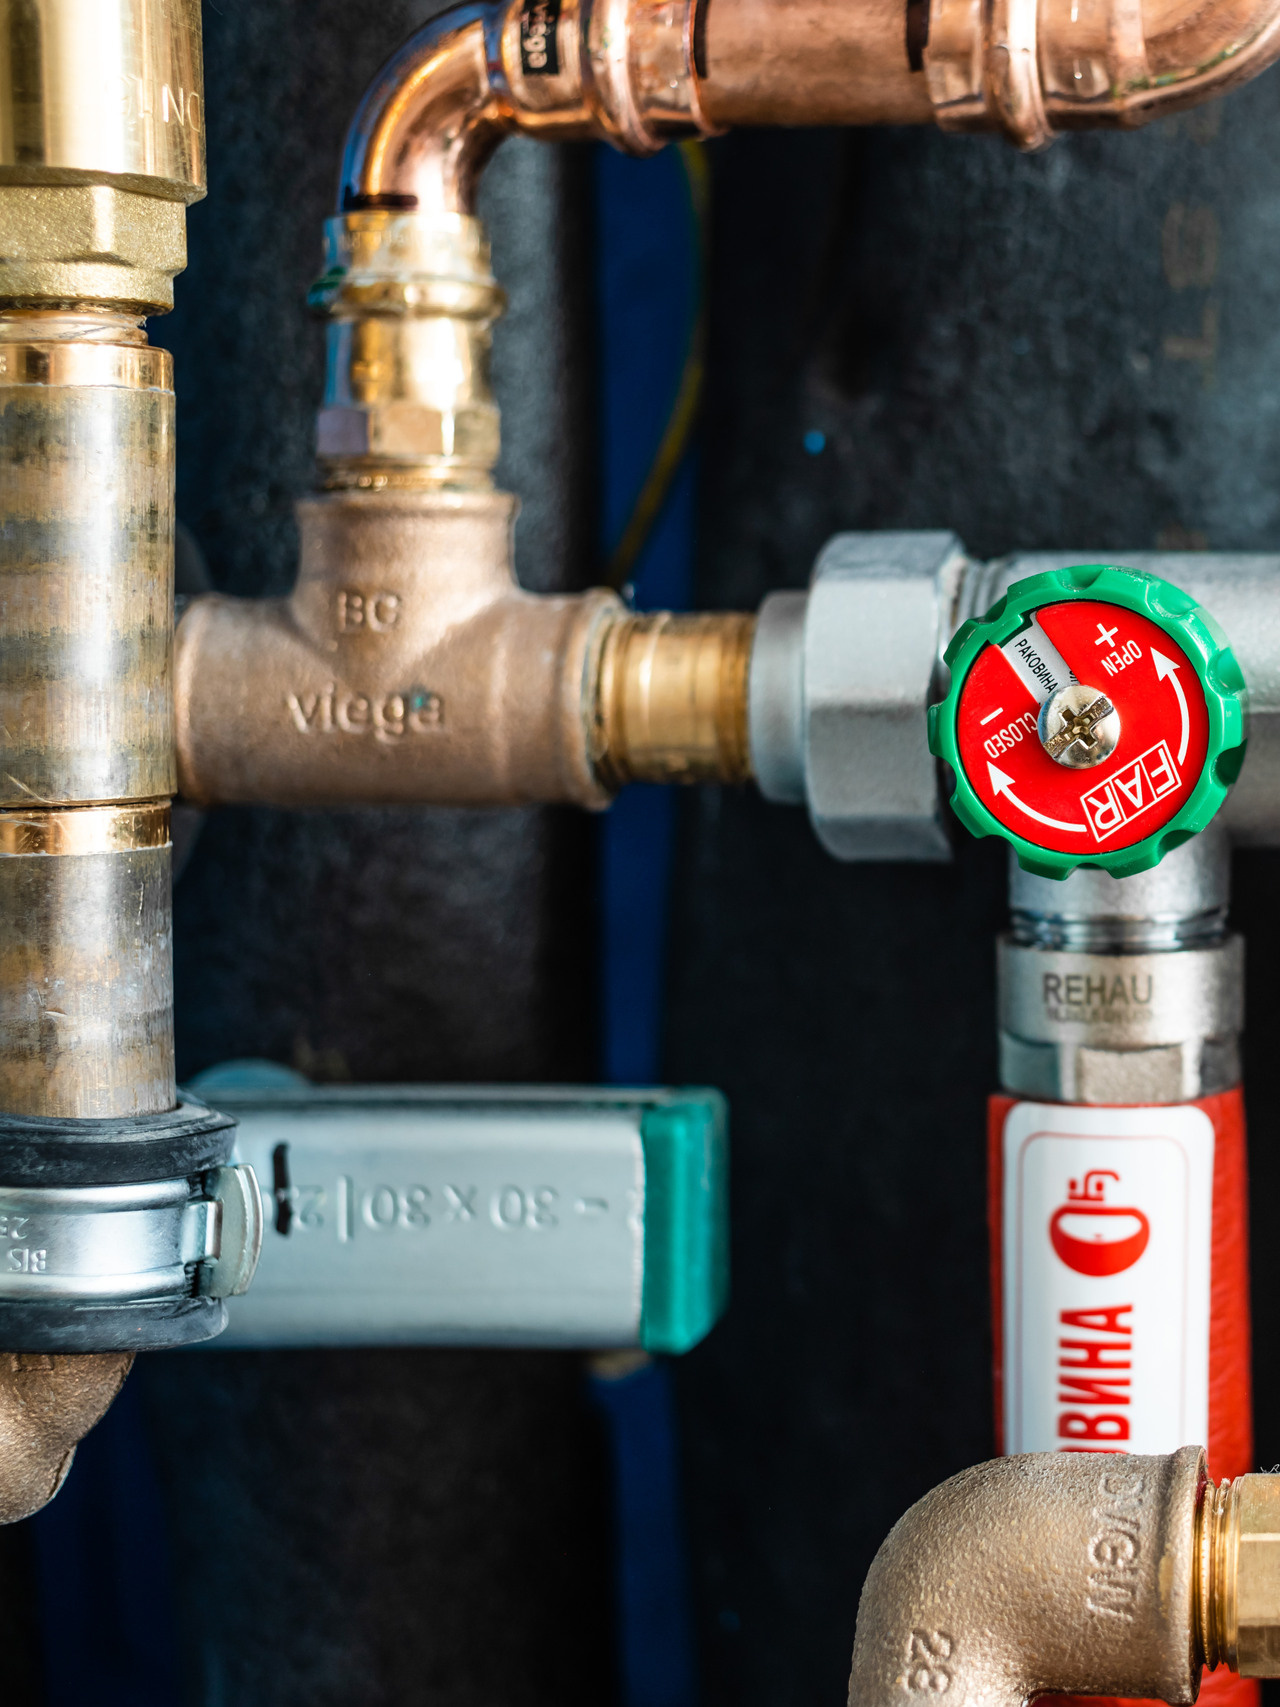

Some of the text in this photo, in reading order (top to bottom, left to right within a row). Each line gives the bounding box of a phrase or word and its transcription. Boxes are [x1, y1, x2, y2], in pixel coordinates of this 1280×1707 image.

[1014, 638, 1059, 694] РАКОВИНА
[1100, 639, 1143, 678] OPEN
[983, 710, 1039, 759] CLOSED
[1084, 745, 1178, 834] FAR
[1042, 973, 1153, 1007] REHAU
[361, 1184, 432, 1231] 30
[490, 1184, 559, 1231] 30
[1057, 1303, 1133, 1453] ВИНА
[902, 1629, 956, 1694] 28
